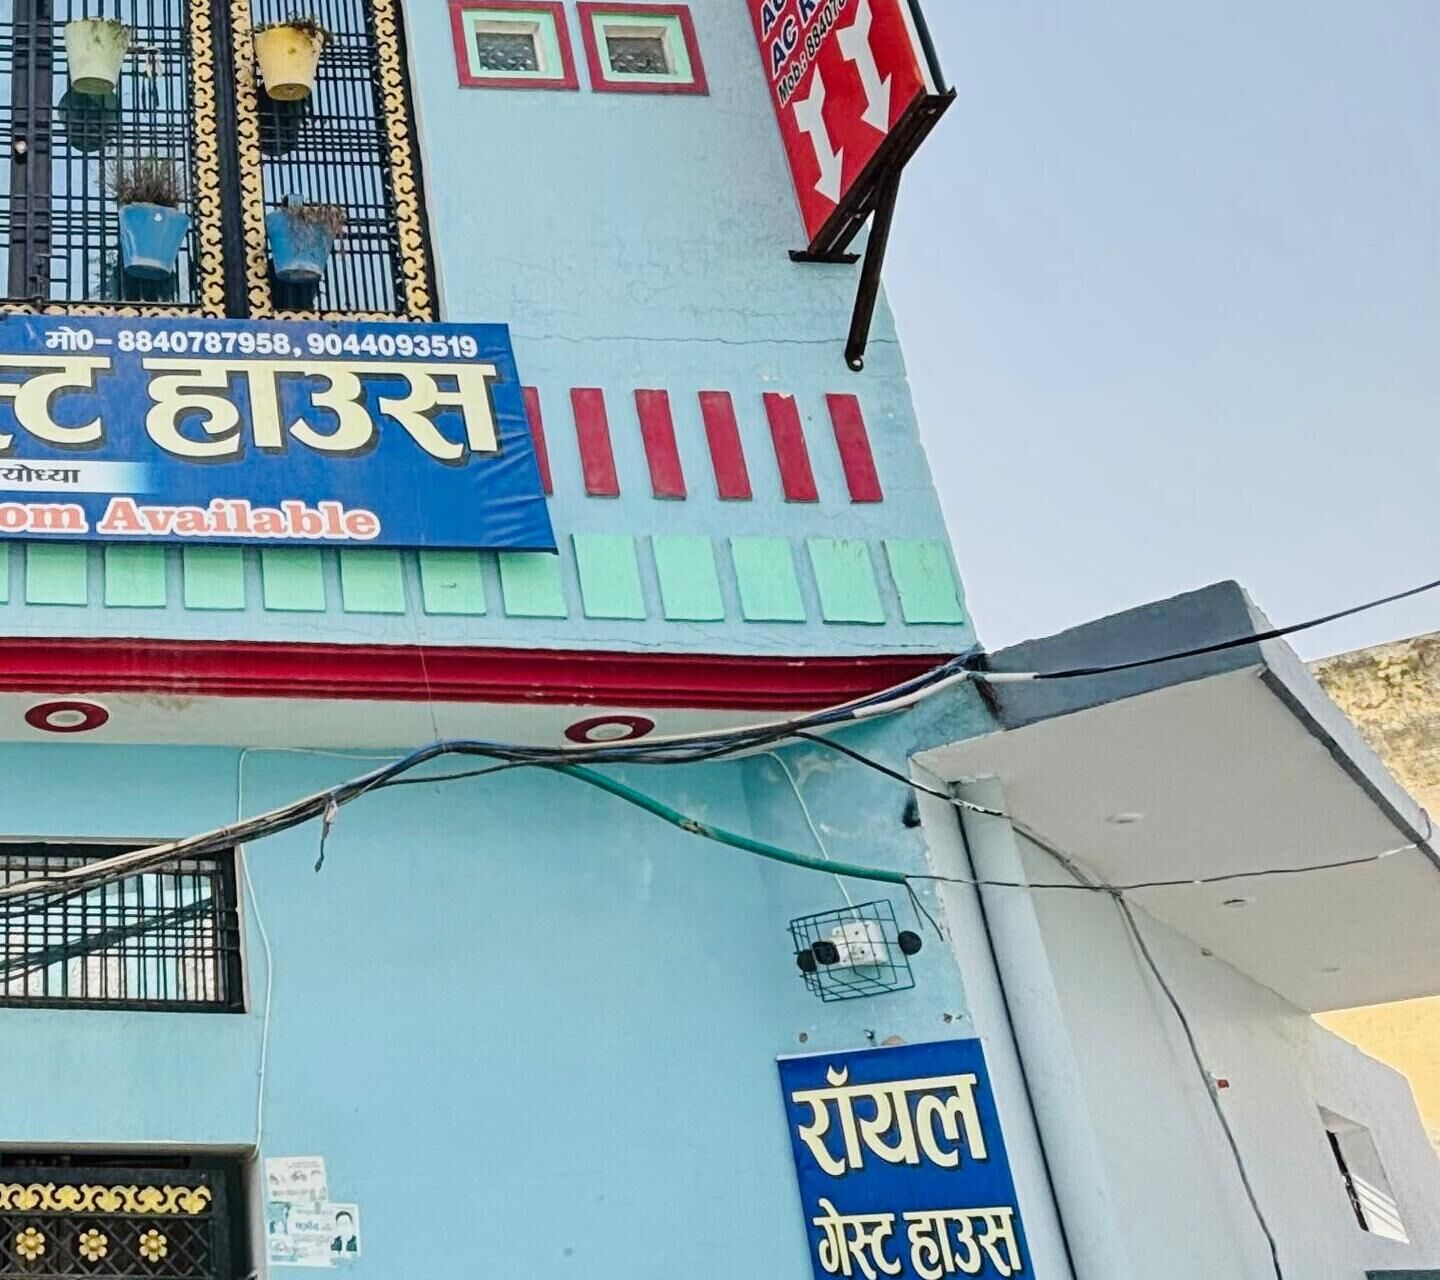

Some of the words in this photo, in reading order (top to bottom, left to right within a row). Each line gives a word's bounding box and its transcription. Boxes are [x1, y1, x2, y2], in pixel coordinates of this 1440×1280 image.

[771, 15, 798, 79] AC
[309, 331, 478, 358] 9044093519
[143, 358, 497, 459] हाउस
[97, 497, 380, 540] Available
[792, 1065, 987, 1176] रॉयल
[813, 1198, 901, 1280] गेस्ट
